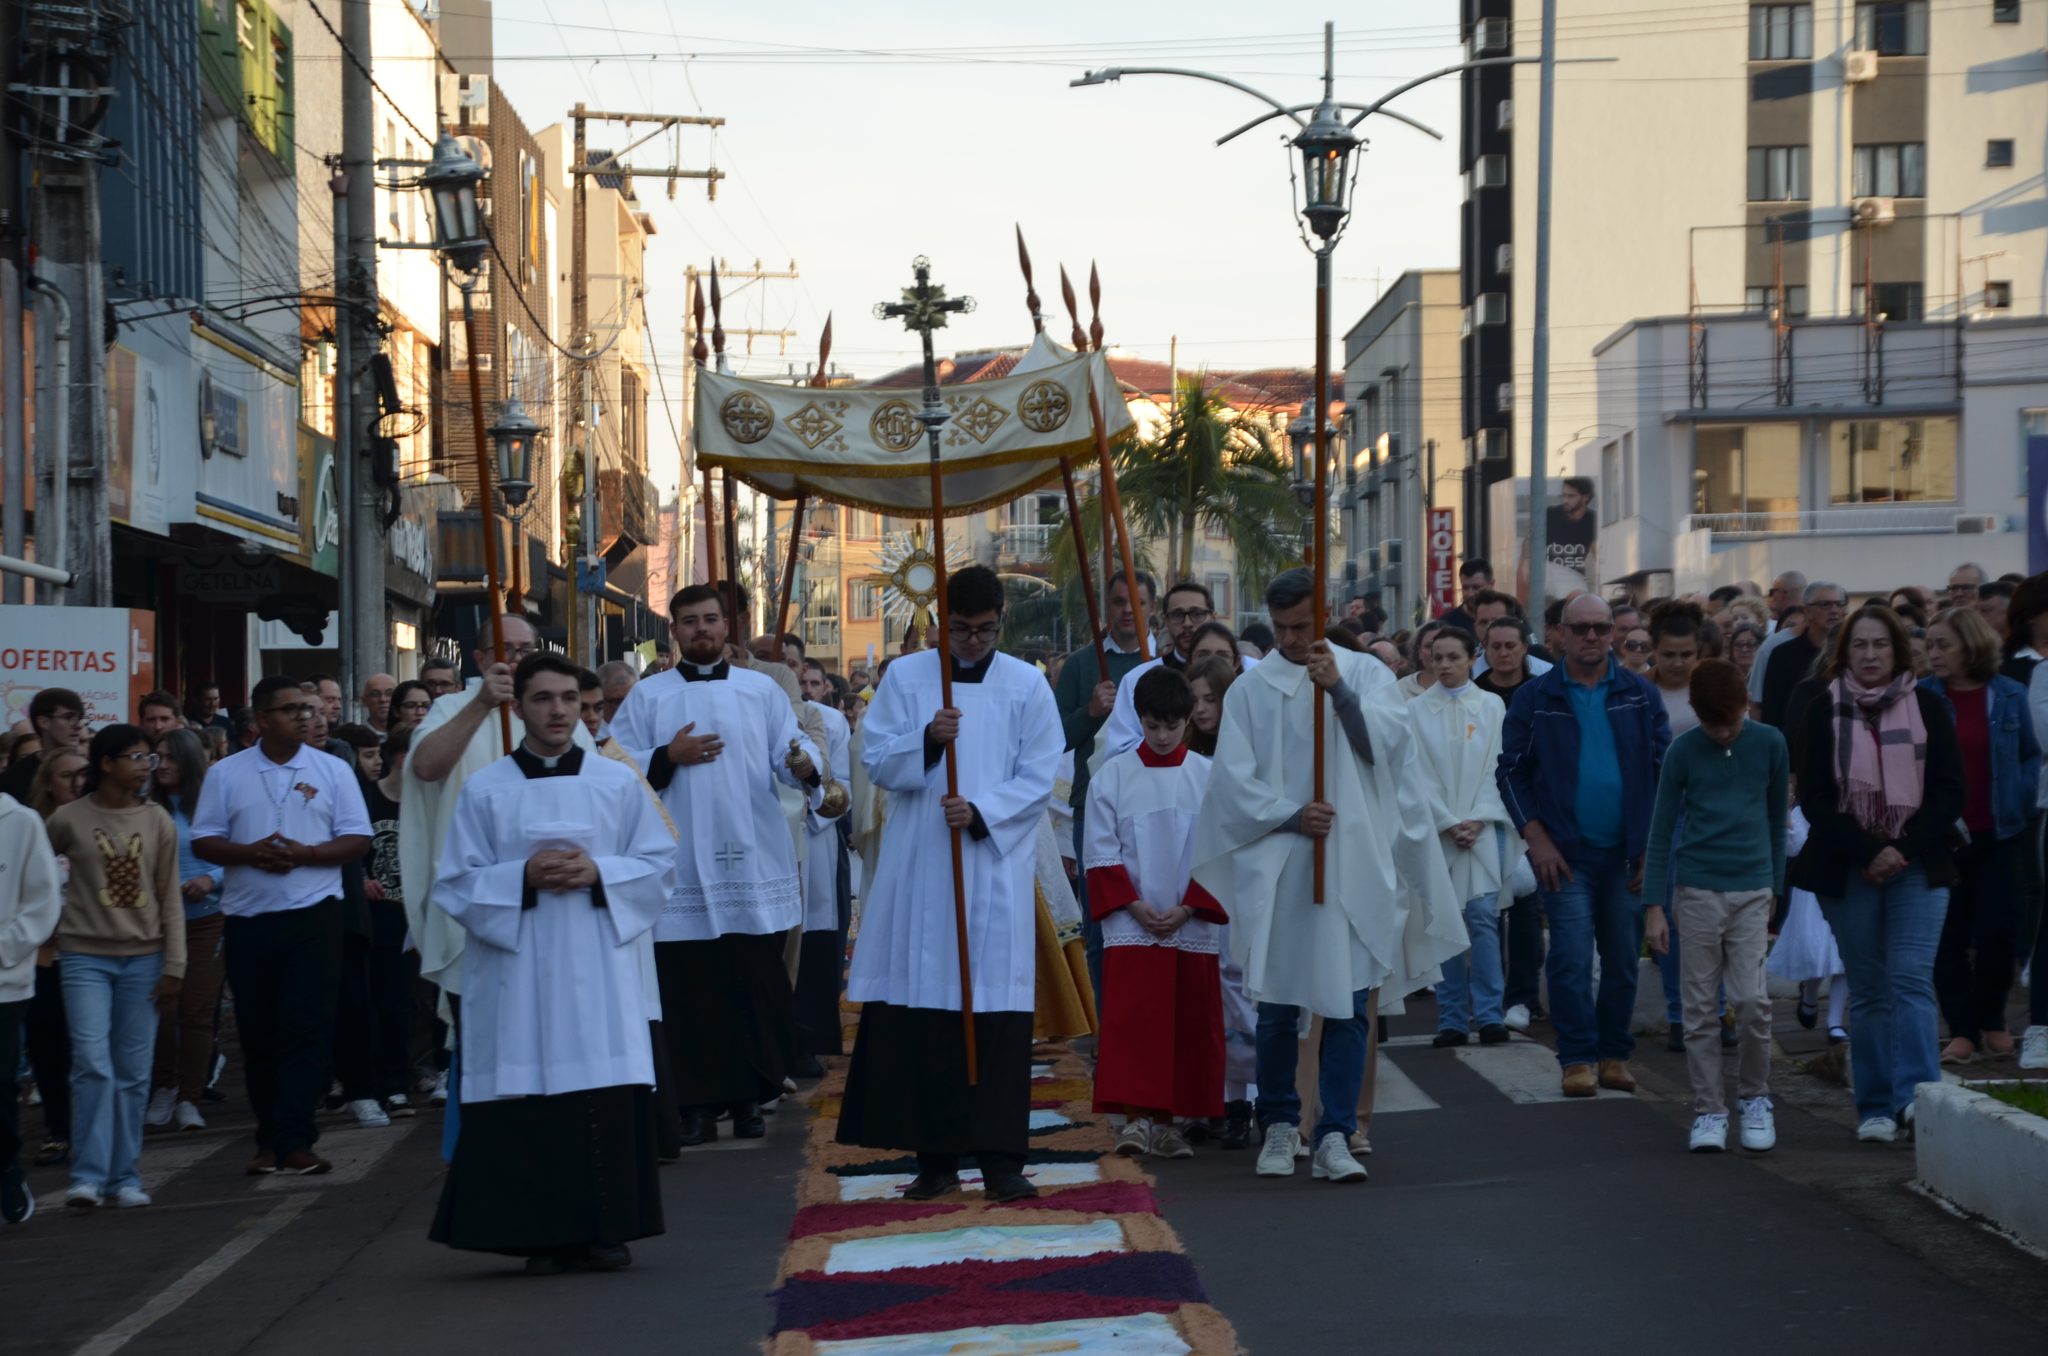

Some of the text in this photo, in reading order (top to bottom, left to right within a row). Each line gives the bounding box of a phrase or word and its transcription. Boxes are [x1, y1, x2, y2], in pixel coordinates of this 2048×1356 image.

[1432, 511, 1453, 608] HOTEL
[1546, 541, 1585, 555] rban
[1, 648, 116, 673] OFERTAS
